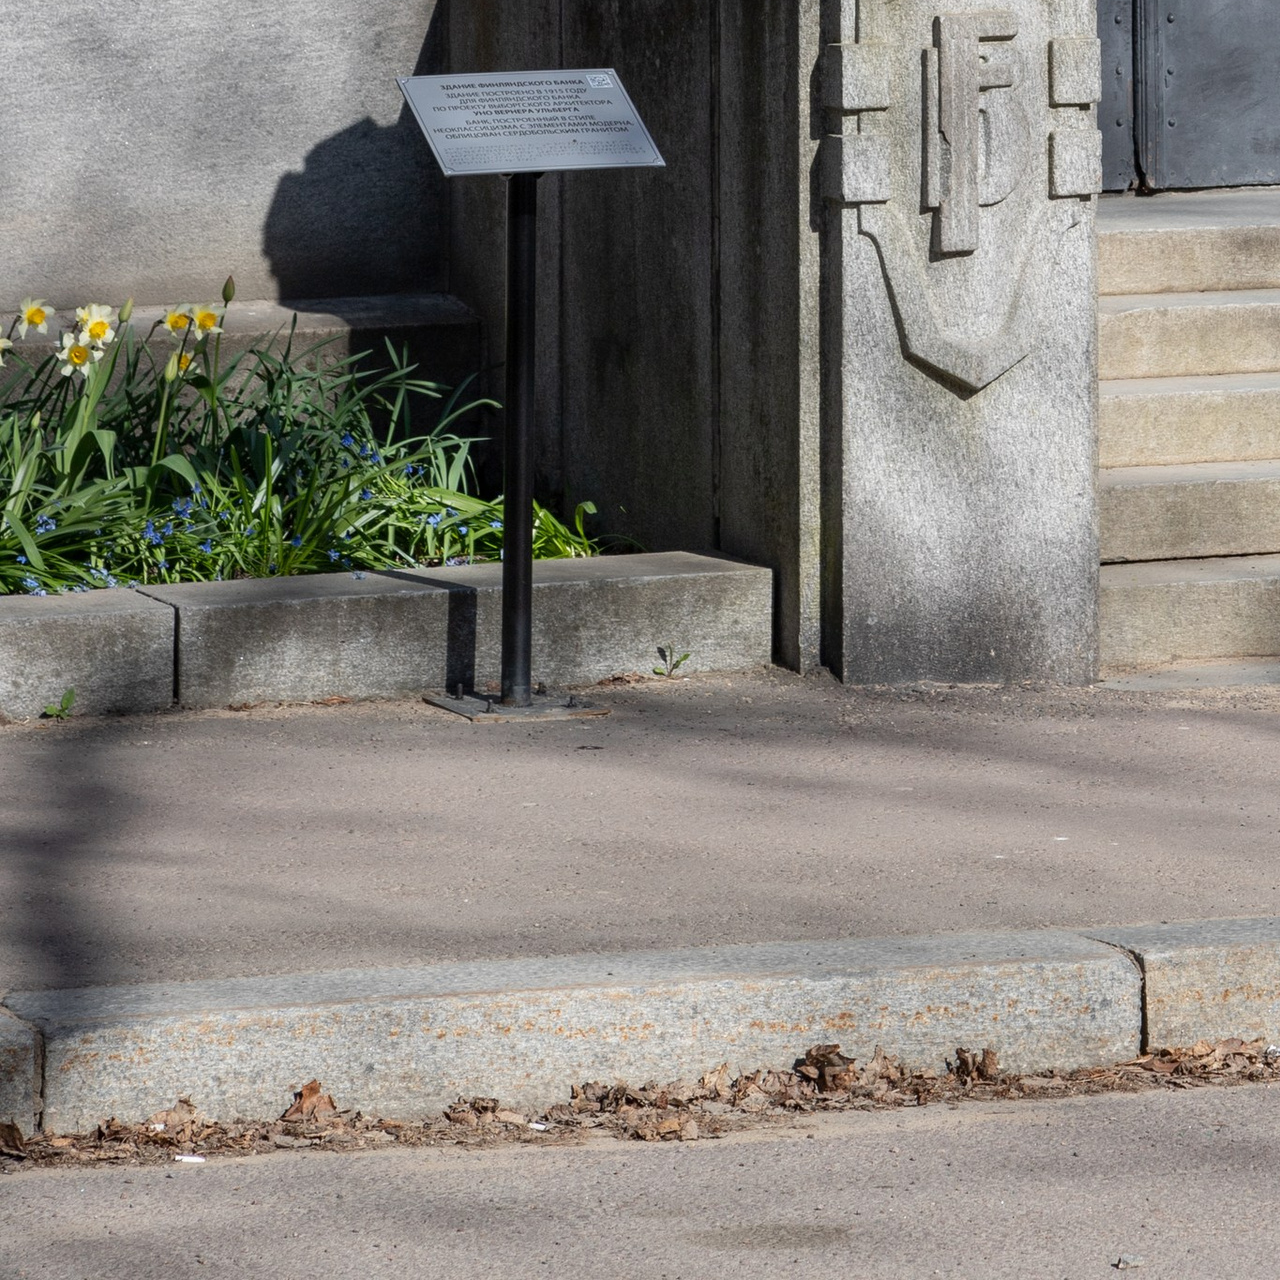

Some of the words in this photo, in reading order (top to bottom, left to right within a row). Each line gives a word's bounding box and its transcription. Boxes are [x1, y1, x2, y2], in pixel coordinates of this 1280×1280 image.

[440, 83, 476, 91] ЗДАНИЕ
[478, 80, 552, 88] ФИНЛЯНДСКОГО
[445, 91, 480, 99] ЗДАНИЕ
[481, 89, 535, 97] ПОСТРОЕНО
[478, 95, 550, 103] ФИНЛЯНДСКОГО
[488, 101, 551, 109] ВЫБОРГСКОГО
[552, 99, 613, 107] АРХИТЕКТОРА
[492, 116, 559, 124] ПОСТРОЕННЫЙ
[433, 125, 519, 134] НЕОКЛАССИЦИЗМА
[527, 121, 588, 129] ЭЛЕМЕНТАМИ
[445, 132, 501, 140] ОБЛИЦОВАН
[502, 128, 580, 137] СЕРДОБОЛЬСКИМ
[581, 126, 629, 134] ГРАНИТОМ
